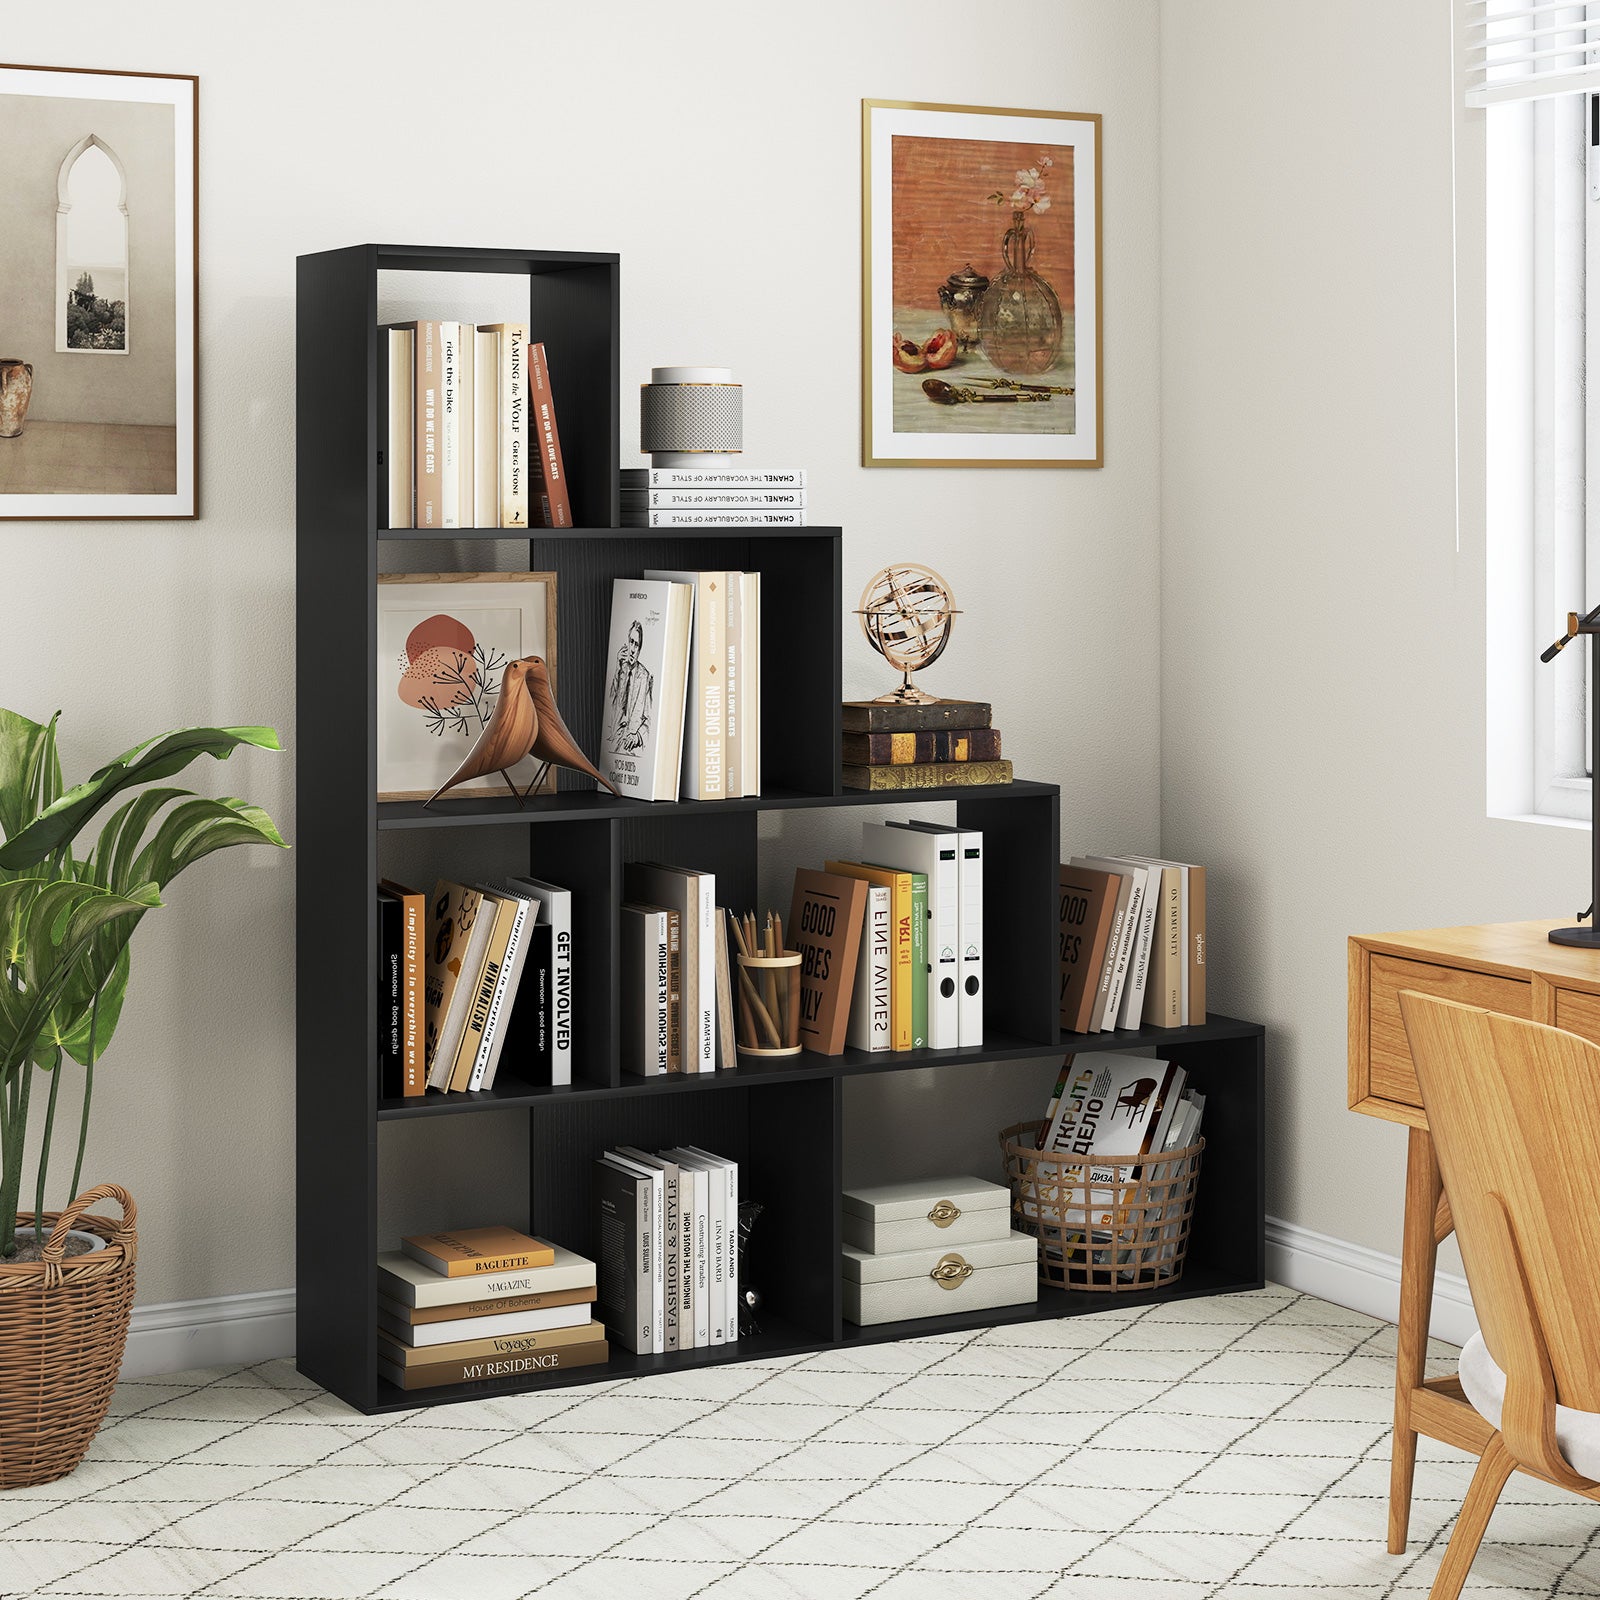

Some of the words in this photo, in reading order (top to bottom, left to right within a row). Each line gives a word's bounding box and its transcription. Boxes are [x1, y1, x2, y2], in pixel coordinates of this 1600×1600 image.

[446, 341, 454, 364] ride
[511, 330, 522, 379] TAMING
[446, 367, 454, 386] the
[426, 389, 435, 406] WHY
[446, 389, 454, 413] bike
[426, 408, 435, 419] DO
[512, 398, 522, 433] WOLF
[541, 404, 549, 420] WHY
[426, 420, 435, 432] WE
[543, 421, 551, 431] DO
[426, 434, 435, 452] LOVE
[545, 432, 552, 444] WE
[512, 440, 520, 466] GREG
[546, 444, 555, 462] LOVE
[426, 454, 435, 474] CATS
[550, 462, 559, 480] CATS
[512, 468, 520, 496] STONE
[728, 645, 736, 664] WHY
[728, 666, 736, 678] DO
[728, 680, 736, 693] WE
[706, 685, 721, 738] ONEGIN
[728, 694, 736, 714] LOVE
[728, 716, 736, 736] CATS
[706, 740, 721, 793] EUGENE
[1170, 888, 1178, 900] ON
[801, 900, 837, 938] GOOD
[1060, 894, 1088, 925] OOD
[1114, 910, 1124, 934] GUIDE
[1123, 916, 1134, 956] sustainable
[1130, 888, 1140, 914] lifestyle
[1170, 906, 1178, 957] IMMUNITY
[408, 907, 416, 960] simplicity
[506, 911, 525, 961] simplicity
[556, 932, 571, 962] GET
[1110, 935, 1118, 958] GOOD
[1136, 961, 1146, 990] DREAM
[1144, 908, 1153, 936] AWAKE
[1195, 934, 1204, 965] spherical
[408, 964, 417, 973] is
[504, 964, 512, 974] is
[1105, 967, 1112, 975] IS
[409, 976, 416, 986] in
[501, 976, 509, 987] in
[1102, 974, 1110, 992] THIS
[470, 961, 500, 1033] MINIMALISM
[801, 987, 824, 1022] NLY
[408, 990, 416, 1047] everything
[484, 989, 504, 1043] everything
[556, 967, 571, 1050] INVOLVED
[538, 1010, 546, 1028] good
[538, 1029, 546, 1051] design
[408, 1050, 416, 1064] we
[480, 1046, 488, 1060] we
[475, 1062, 484, 1080] see
[1052, 1069, 1094, 1153] ТКРЫТЬ
[1072, 1098, 1104, 1156] ДЕЛО
[1090, 1172, 1126, 1184] ДИЗАН
[668, 1179, 677, 1232] STYLE
[642, 1232, 650, 1248] LOUIS
[668, 1236, 677, 1248] &
[698, 1214, 706, 1258] Constructing
[716, 1242, 722, 1254] BO
[475, 1256, 529, 1272] BAGUETTE
[642, 1248, 650, 1274] SULLIVAN
[488, 1278, 532, 1293] MAGAZINE
[668, 1253, 677, 1327] FASHION
[468, 1302, 496, 1313] House
[496, 1301, 506, 1309] Of
[642, 1326, 650, 1338] CCA
[493, 1336, 536, 1353] Voyage
[462, 1364, 484, 1379] MY
[488, 1354, 559, 1376] RESIDENCE
